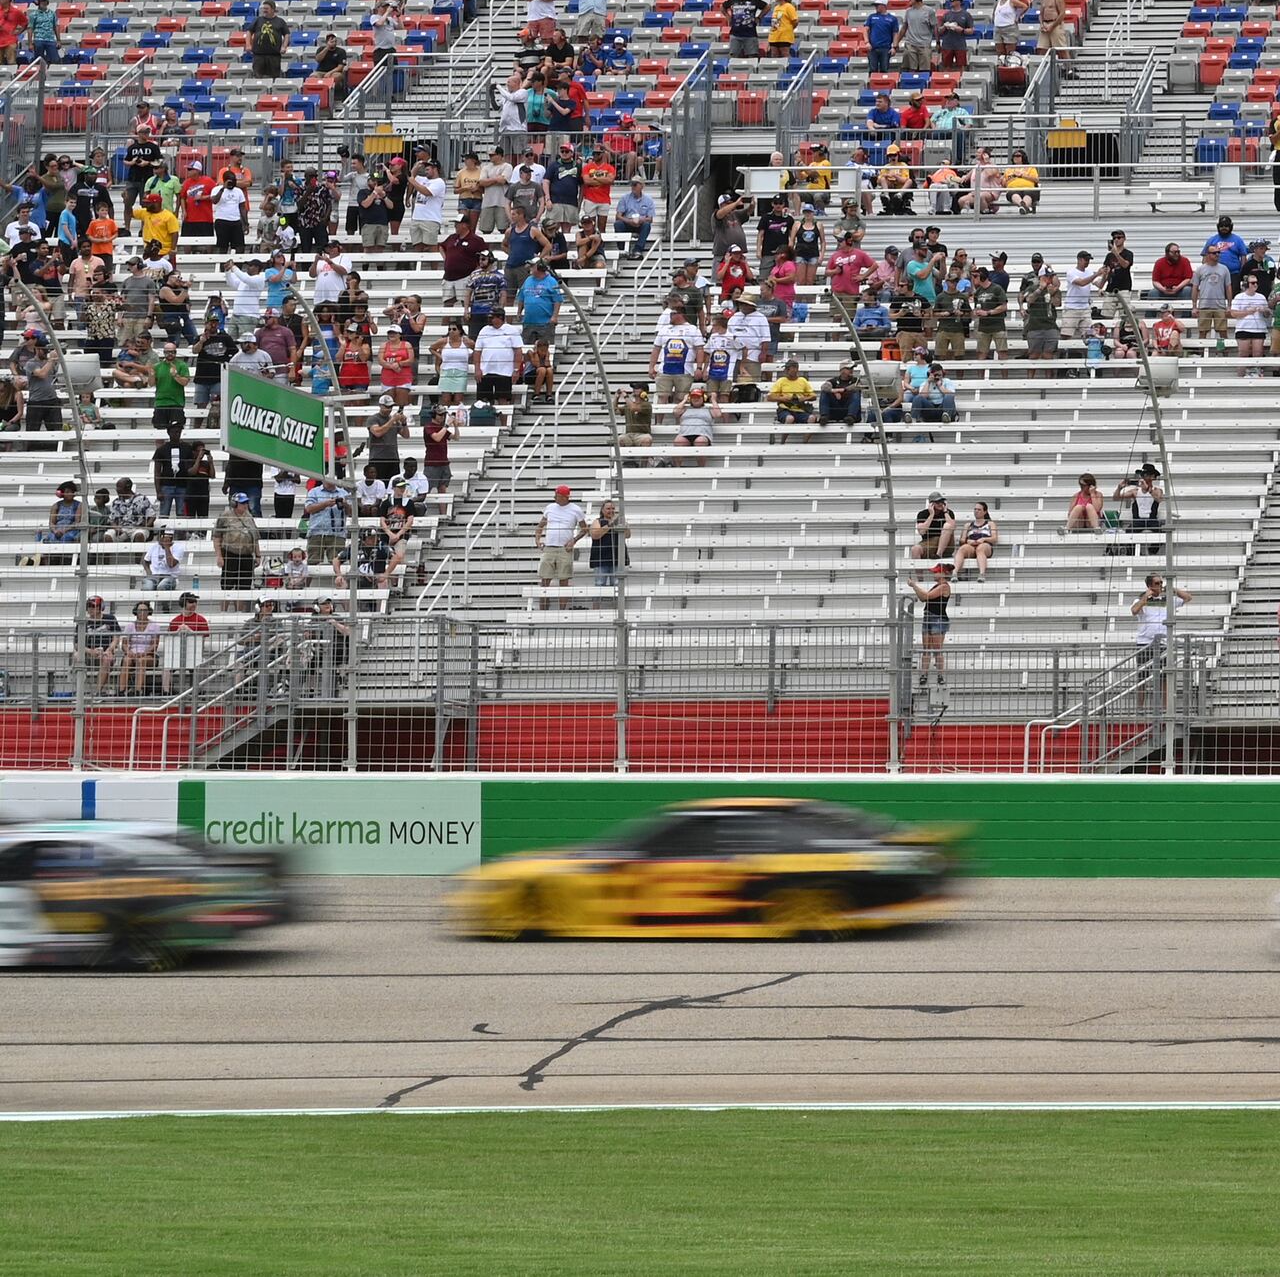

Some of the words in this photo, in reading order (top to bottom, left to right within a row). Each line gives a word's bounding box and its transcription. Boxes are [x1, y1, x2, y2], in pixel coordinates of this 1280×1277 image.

[131, 148, 152, 156] DAD
[230, 395, 282, 437] QUAKER
[281, 417, 318, 449] STATE
[206, 811, 285, 845] credit
[292, 812, 381, 845] karma
[389, 821, 475, 845] MONEY
